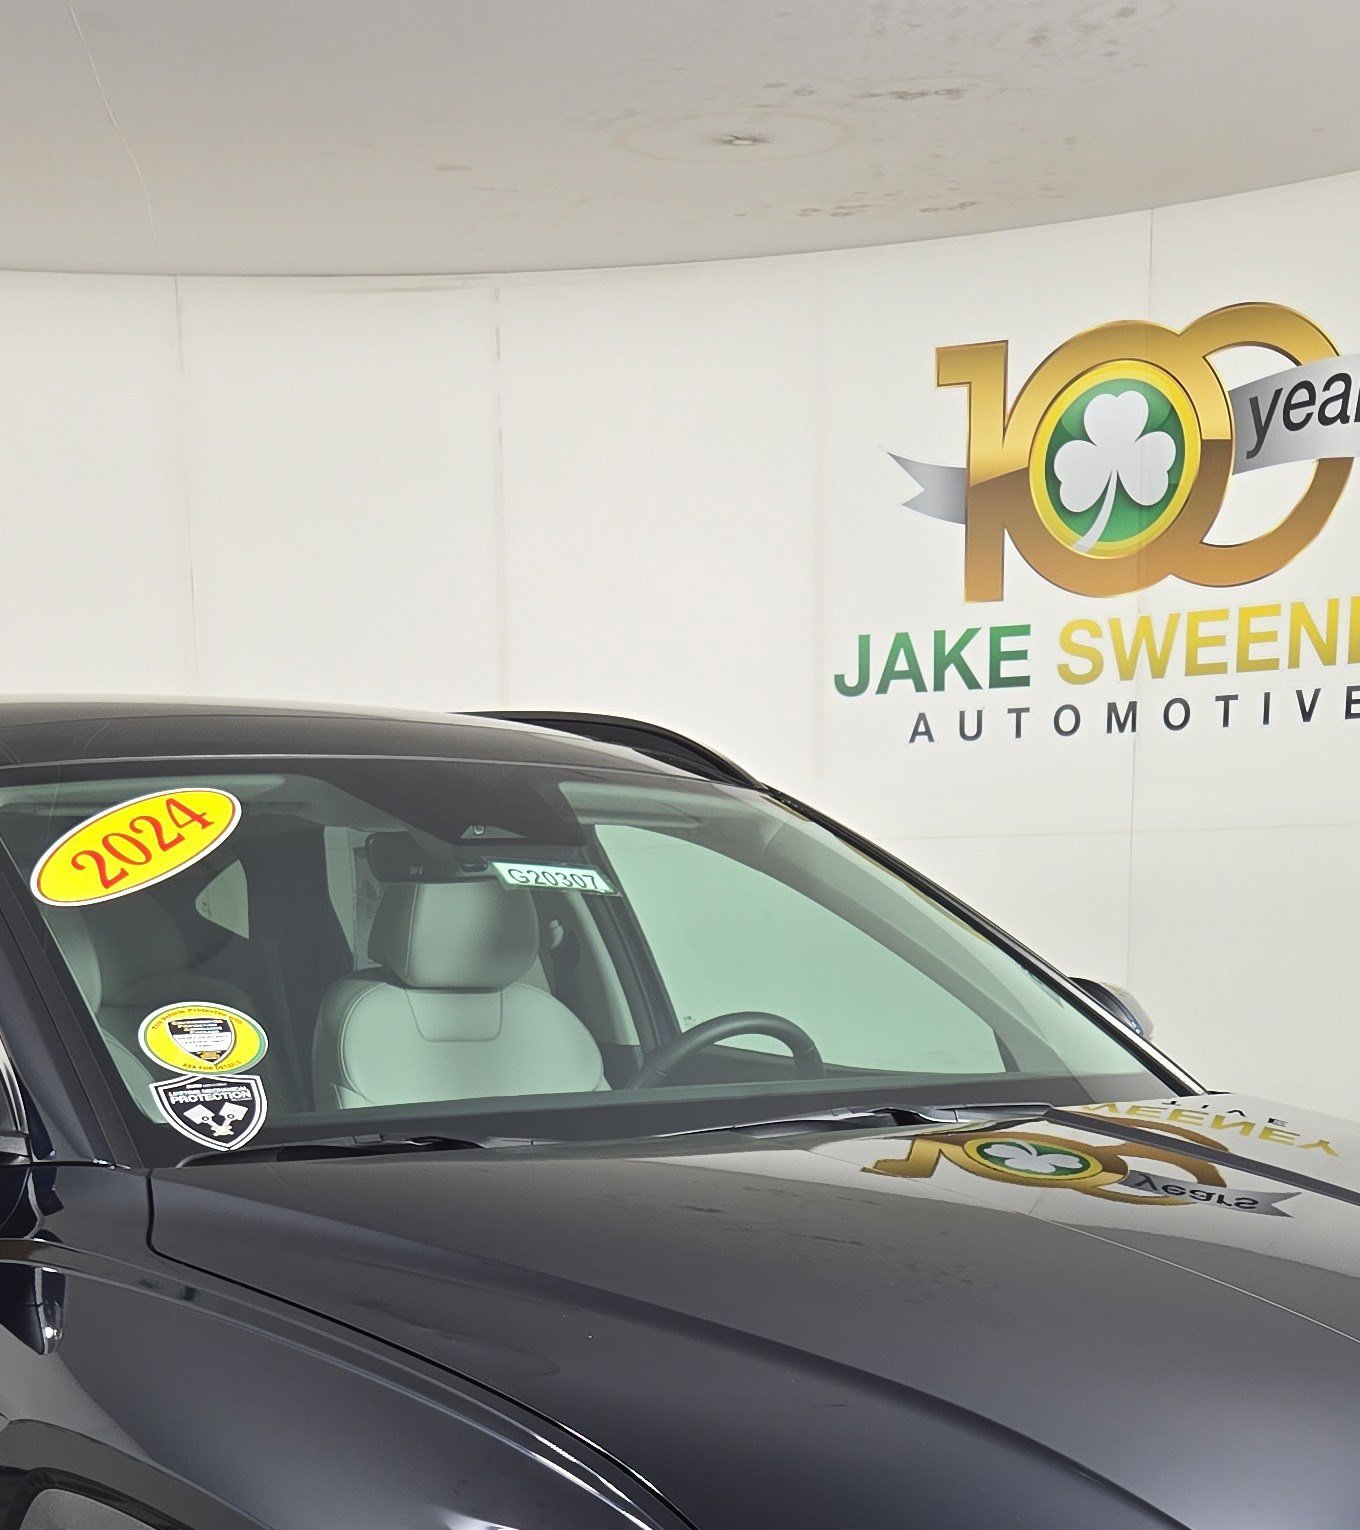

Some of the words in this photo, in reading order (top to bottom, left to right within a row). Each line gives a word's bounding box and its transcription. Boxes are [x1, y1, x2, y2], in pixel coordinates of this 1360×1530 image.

[935, 302, 1356, 604] 100
[834, 624, 1032, 698] JAKE
[70, 796, 216, 890] 2024
[507, 868, 599, 890] G20307
[169, 1090, 252, 1105] PROTECTION
